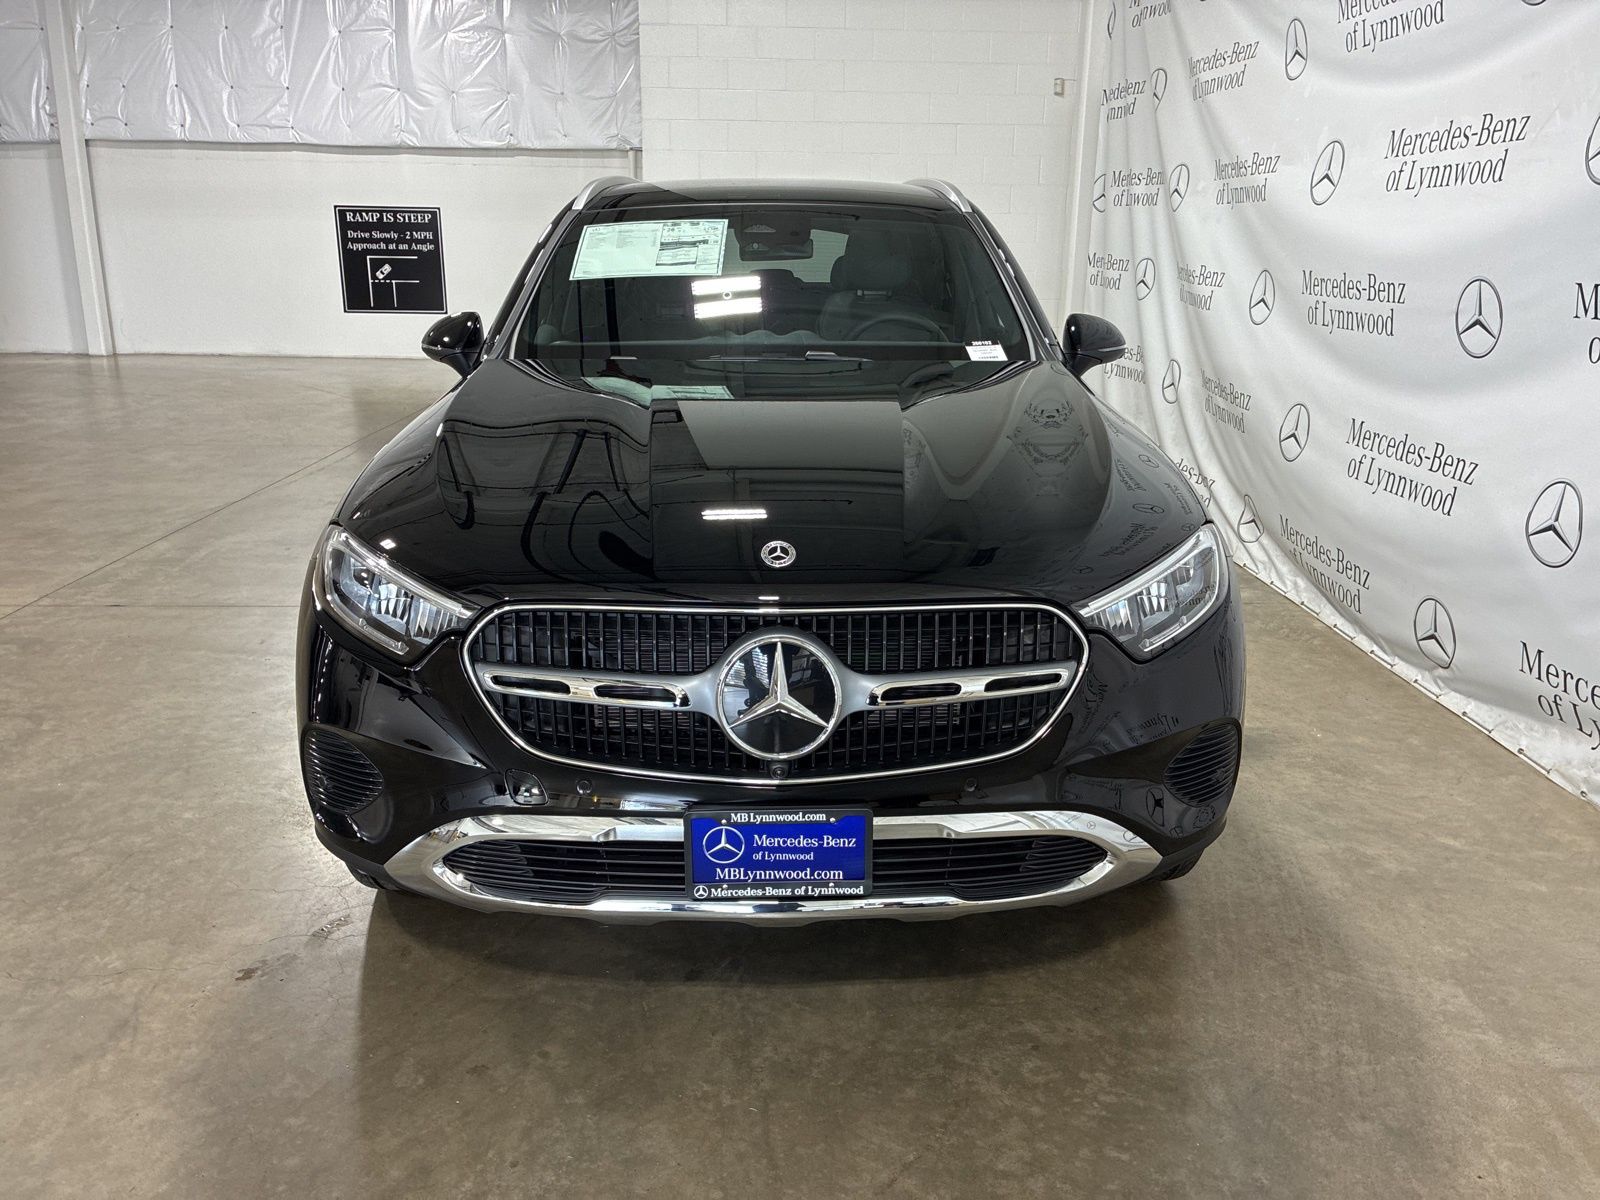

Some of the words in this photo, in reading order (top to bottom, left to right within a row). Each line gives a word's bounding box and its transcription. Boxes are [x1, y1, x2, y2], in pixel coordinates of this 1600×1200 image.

[1345, 19, 1362, 53] of
[1362, 0, 1444, 52] Lynnwood
[1383, 113, 1531, 159] Mercedes-Benz
[1214, 152, 1280, 182] Mercedes-Benz
[1385, 162, 1405, 193] of
[1405, 148, 1509, 198] Lynnwood
[1113, 190, 1126, 207] of
[1216, 183, 1227, 206] of
[1226, 177, 1268, 210] Lynnwood
[345, 211, 380, 222] RAMP
[383, 212, 394, 223] IS
[396, 212, 432, 223] STEEP
[346, 241, 387, 251] Approach
[388, 241, 397, 250] at
[410, 242, 435, 252] Angle
[347, 230, 370, 239] Drive
[371, 230, 399, 240] Slowly
[405, 231, 411, 239] 2
[412, 231, 433, 240] MPH
[1090, 270, 1101, 286] of
[1301, 269, 1406, 304] Mercedes-Benz
[1307, 300, 1320, 325] of
[1321, 301, 1395, 337] Lynnwood
[1346, 418, 1479, 486] Mercedes-Benz
[1347, 455, 1367, 480] of
[1364, 457, 1458, 517] Lynnwood
[1279, 514, 1370, 590] Mercedes-Benz
[1538, 694, 1567, 724] of
[752, 834, 857, 848] Mercedes-Benz
[752, 851, 764, 860] of
[764, 851, 814, 862] Lynnwood
[715, 867, 844, 883] MBLynnwood.com
[711, 887, 792, 897] Mercedes-Benz
[794, 885, 806, 896] of
[807, 885, 864, 898] Lynnwood
